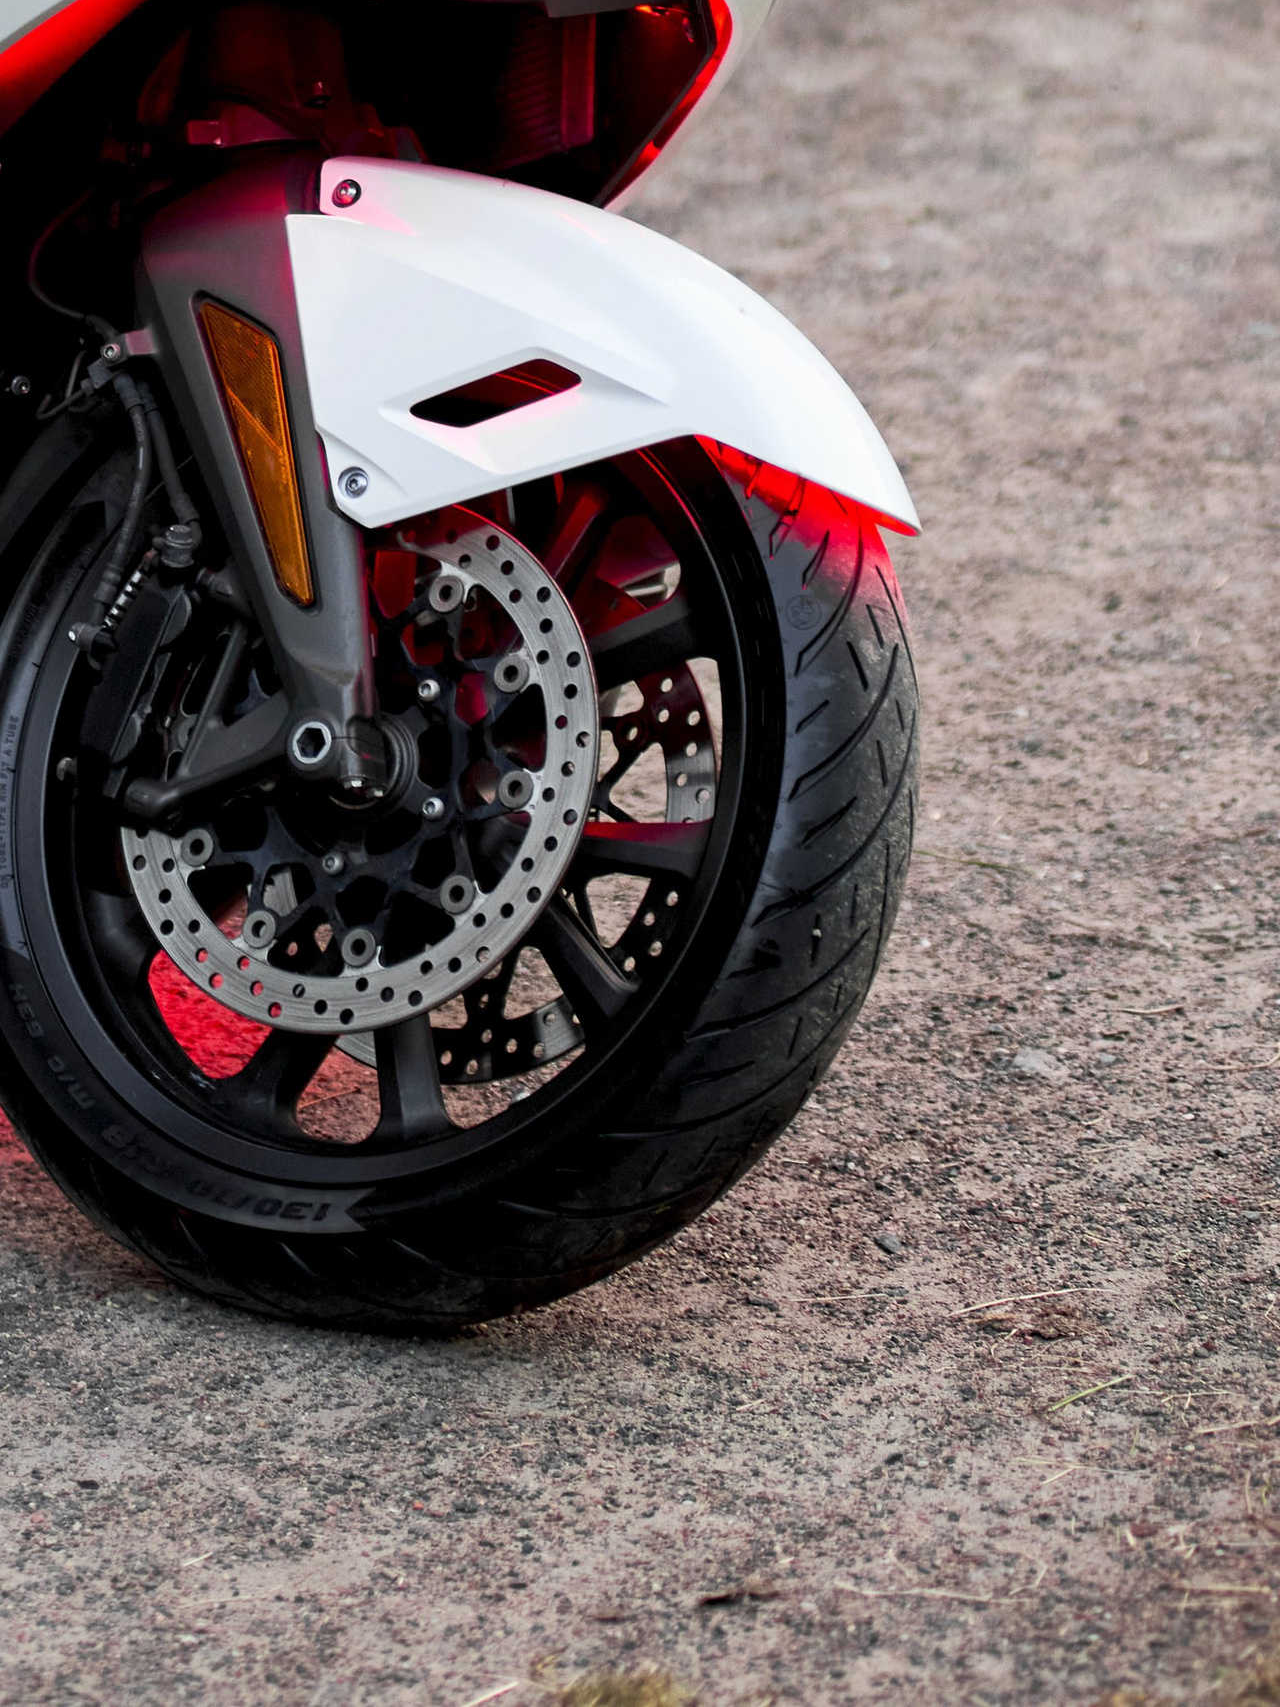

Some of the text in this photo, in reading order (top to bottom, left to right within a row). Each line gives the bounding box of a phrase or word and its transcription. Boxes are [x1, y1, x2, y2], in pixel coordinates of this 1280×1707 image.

[4, 715, 19, 744] TUBE
[2, 749, 12, 757] A
[8, 984, 45, 1039] 63H
[186, 1180, 332, 1222] 130/70
